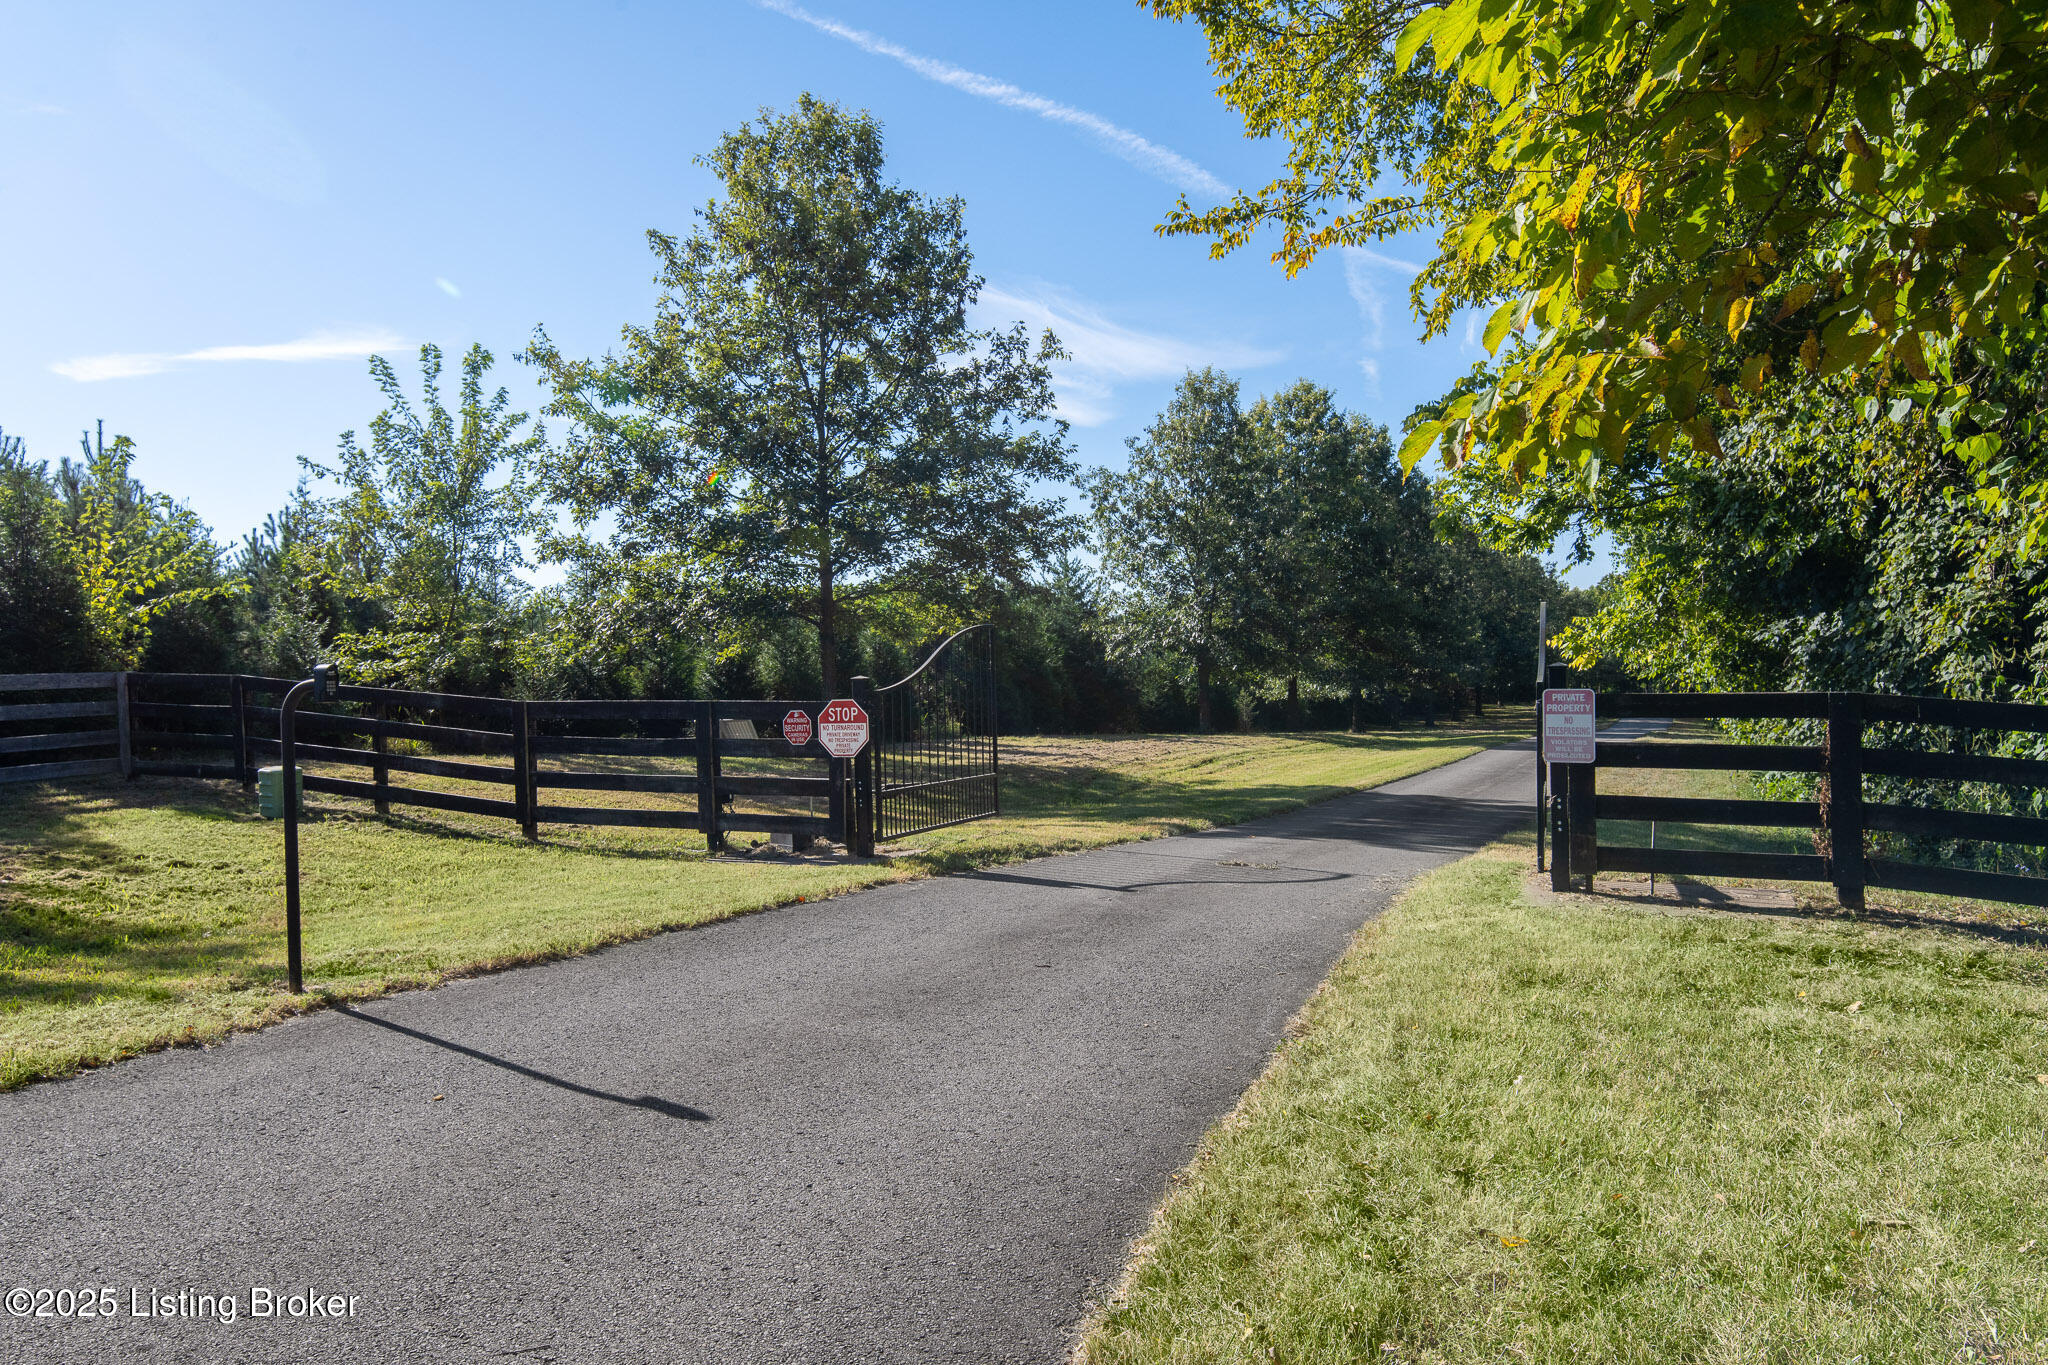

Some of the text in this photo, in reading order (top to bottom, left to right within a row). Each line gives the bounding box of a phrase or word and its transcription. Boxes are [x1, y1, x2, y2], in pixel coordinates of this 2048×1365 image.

[1552, 693, 1585, 702] PRIVATE
[1546, 703, 1591, 712] PROPERTY
[828, 707, 858, 721] STOP
[1564, 716, 1574, 725] NO
[784, 724, 809, 732] SECURITY
[1547, 726, 1591, 736] TRESPASSING
